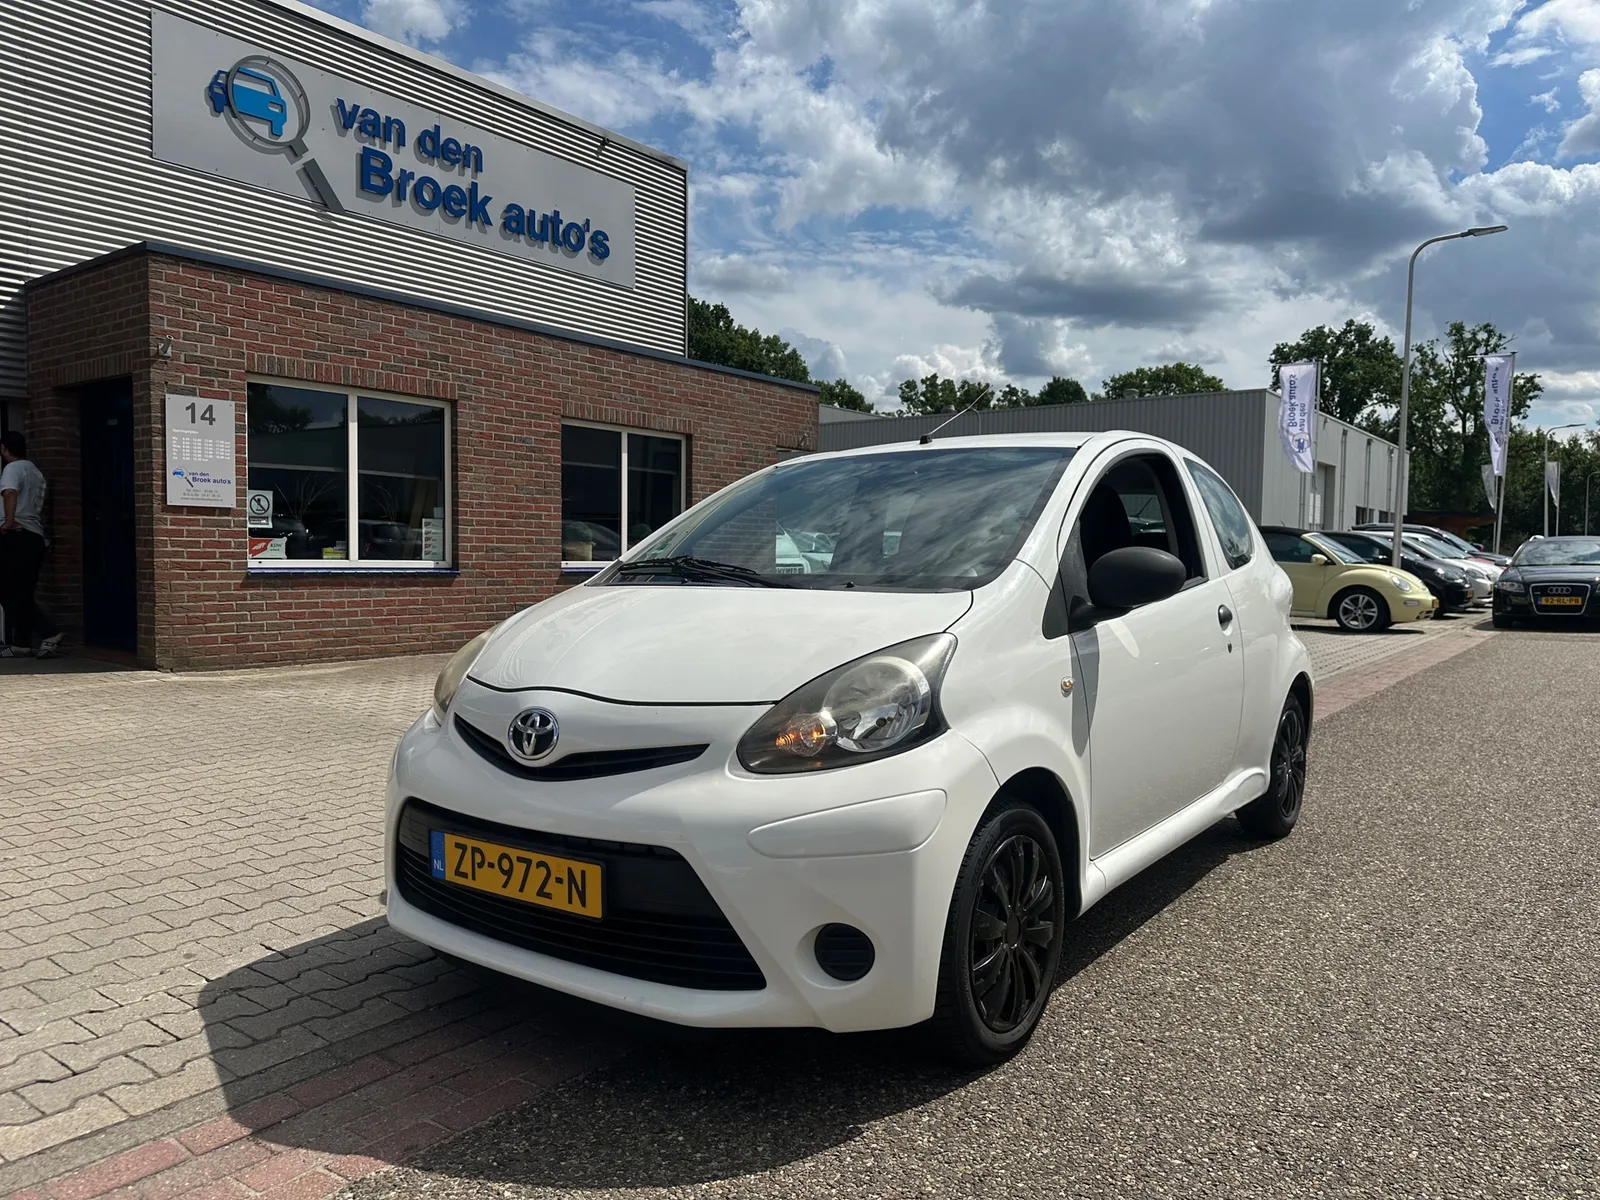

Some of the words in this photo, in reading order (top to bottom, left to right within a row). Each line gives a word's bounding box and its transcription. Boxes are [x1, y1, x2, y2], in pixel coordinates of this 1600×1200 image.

[336, 97, 406, 147] van
[419, 124, 483, 173] den
[362, 145, 493, 226] Broek
[504, 202, 610, 260] auto's
[185, 402, 216, 426] 14
[192, 476, 211, 484] Broek
[433, 858, 444, 871] NL
[453, 841, 587, 908] ZP-972-N
